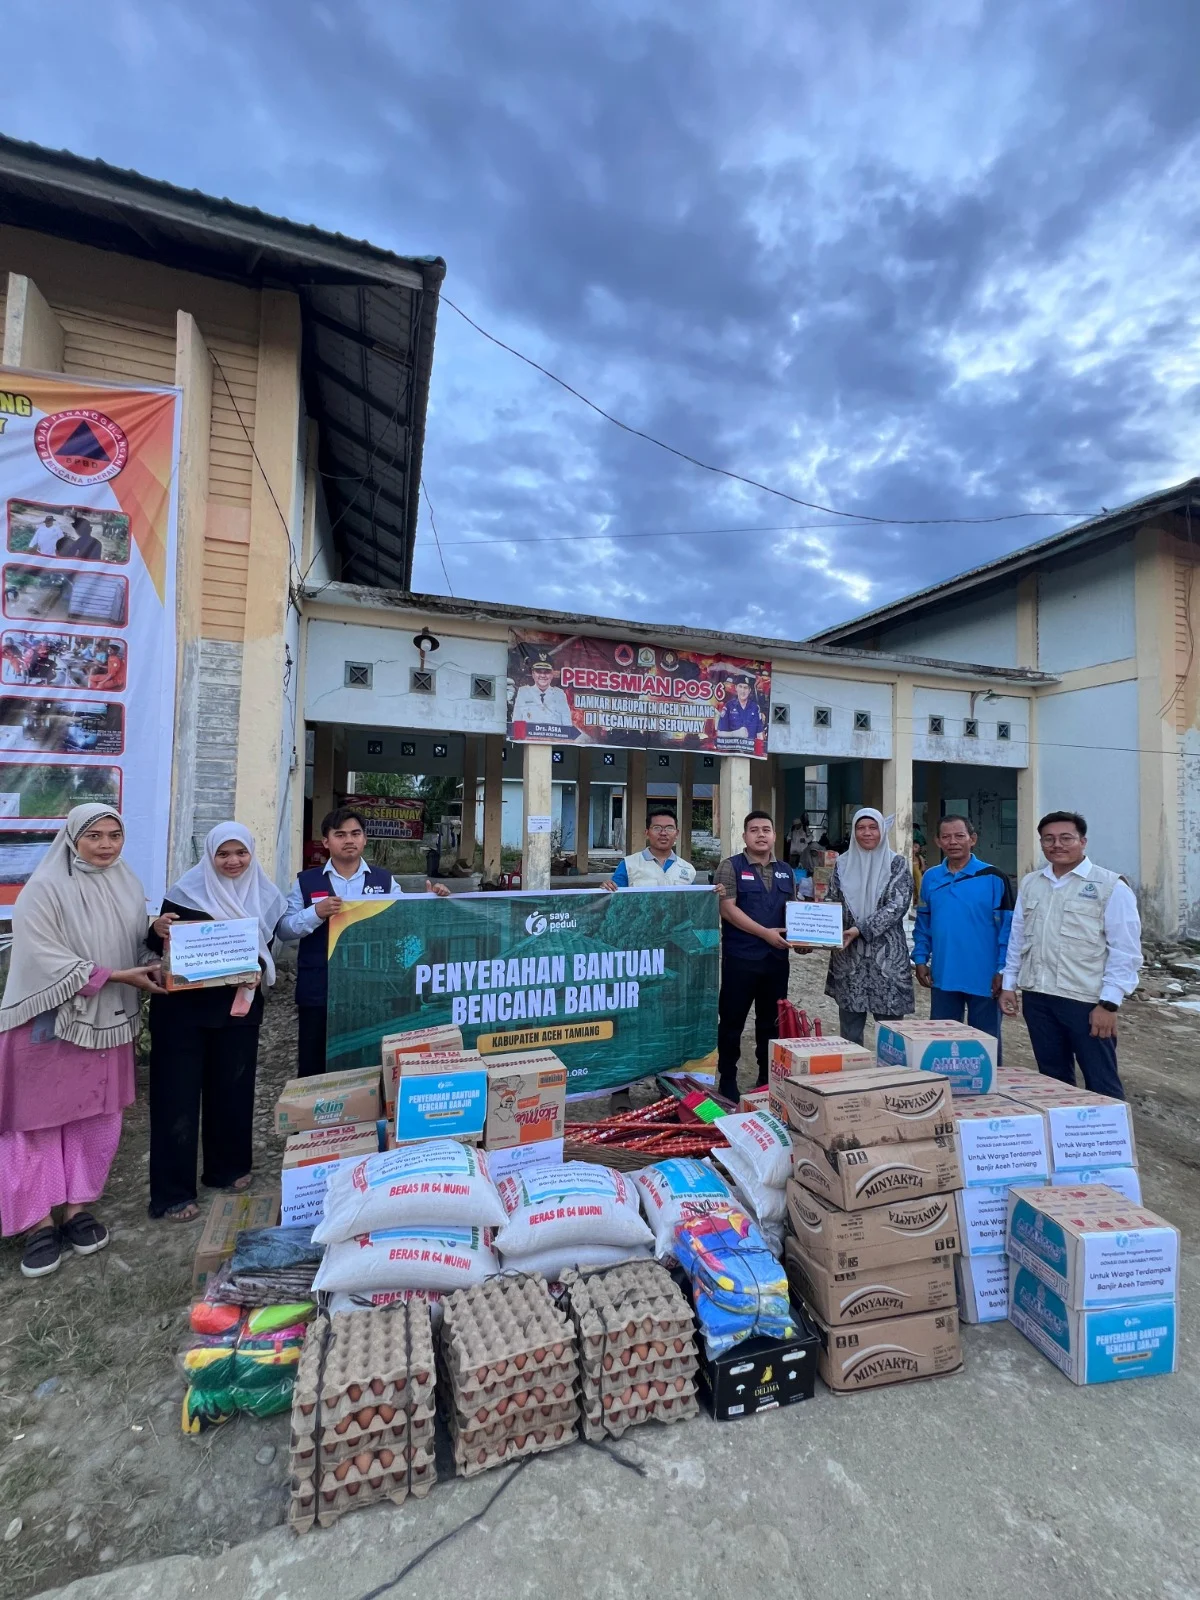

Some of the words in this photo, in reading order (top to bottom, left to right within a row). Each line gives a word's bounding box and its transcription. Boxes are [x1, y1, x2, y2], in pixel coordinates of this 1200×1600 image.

[38, 421, 50, 457] BADAN
[51, 410, 126, 468] PENANGGULANGAN
[66, 458, 98, 468] BPBD
[46, 460, 83, 484] BENCANA
[87, 467, 117, 484] DAERAH
[562, 668, 670, 696] PERESMIAN
[674, 679, 712, 699] POS
[715, 683, 725, 700] 6
[575, 695, 610, 709] DAMKAR
[611, 698, 658, 714] KABUPATEN
[659, 701, 680, 716] ACEH
[681, 704, 715, 718] TAMIANG
[585, 712, 598, 725] DI
[599, 713, 658, 730] KECAMATAN
[659, 720, 705, 733] SERUWAY
[374, 808, 420, 820] SERUWAY
[374, 828, 412, 837] TAMIANG
[549, 912, 570, 921] saya
[549, 919, 577, 932] peduli
[196, 950, 219, 958] Warga
[220, 946, 256, 956] Terdampak
[222, 955, 250, 963] Tamiang
[415, 955, 566, 995] PENYERAHAN
[573, 948, 665, 982] BANTUAN
[452, 988, 557, 1026] BENCANA
[564, 981, 640, 1015] BANJIR
[492, 1032, 540, 1048] KABUPATEN
[541, 1029, 562, 1041] ACEH
[565, 1025, 600, 1039] TAMIANG
[408, 1092, 450, 1104] PENYERAHAN
[451, 1089, 480, 1100] BANTUAN
[313, 1100, 344, 1115] Klin
[418, 1101, 448, 1112] BENCANA
[449, 1099, 472, 1109] BANJIR
[313, 1112, 342, 1121] Lantai
[1075, 1141, 1096, 1149] Warga
[1096, 1138, 1127, 1147] Terdampak
[396, 1155, 421, 1164] Warga
[422, 1150, 462, 1158] Terdampak
[987, 1152, 1009, 1160] Warga
[1010, 1149, 1042, 1158] Terdampak
[1098, 1149, 1122, 1157] Tamiang
[404, 1160, 424, 1168] Aceh
[1012, 1160, 1037, 1168] Tamiang
[550, 1172, 572, 1180] Warga
[573, 1171, 608, 1179] Terdampak
[389, 1184, 419, 1197] BERAS
[421, 1183, 431, 1193] IR
[432, 1183, 442, 1193] 64
[443, 1184, 470, 1196] MURNI
[865, 1173, 924, 1199] MINYAKITA
[284, 1203, 306, 1212] Untuk
[307, 1200, 323, 1208] War
[292, 1212, 312, 1221] Banjir
[529, 1210, 555, 1225] BERAS
[556, 1208, 565, 1219] IR
[566, 1207, 577, 1217] 64
[577, 1205, 603, 1216] MURNI
[888, 1202, 942, 1226] MINYAKITA
[971, 1219, 989, 1227] Untuk
[990, 1218, 1007, 1227] Warg
[980, 1229, 998, 1238] Banjir
[389, 1249, 419, 1261] BERAS
[421, 1250, 430, 1262] IR
[431, 1251, 443, 1264] 64
[444, 1254, 471, 1271] MURNI
[1135, 1266, 1171, 1275] Terdampak
[1097, 1283, 1117, 1291] Banjir
[1136, 1279, 1164, 1287] Tamiang
[980, 1289, 998, 1297] Untuk
[849, 1296, 904, 1318] MINYAKITA
[989, 1299, 1006, 1308] Banjir
[1096, 1331, 1138, 1346] PENYERAHAN
[1105, 1341, 1136, 1355] BENCANA
[853, 1357, 918, 1383] MINYAKITA
[754, 1384, 780, 1397] DELIMA
